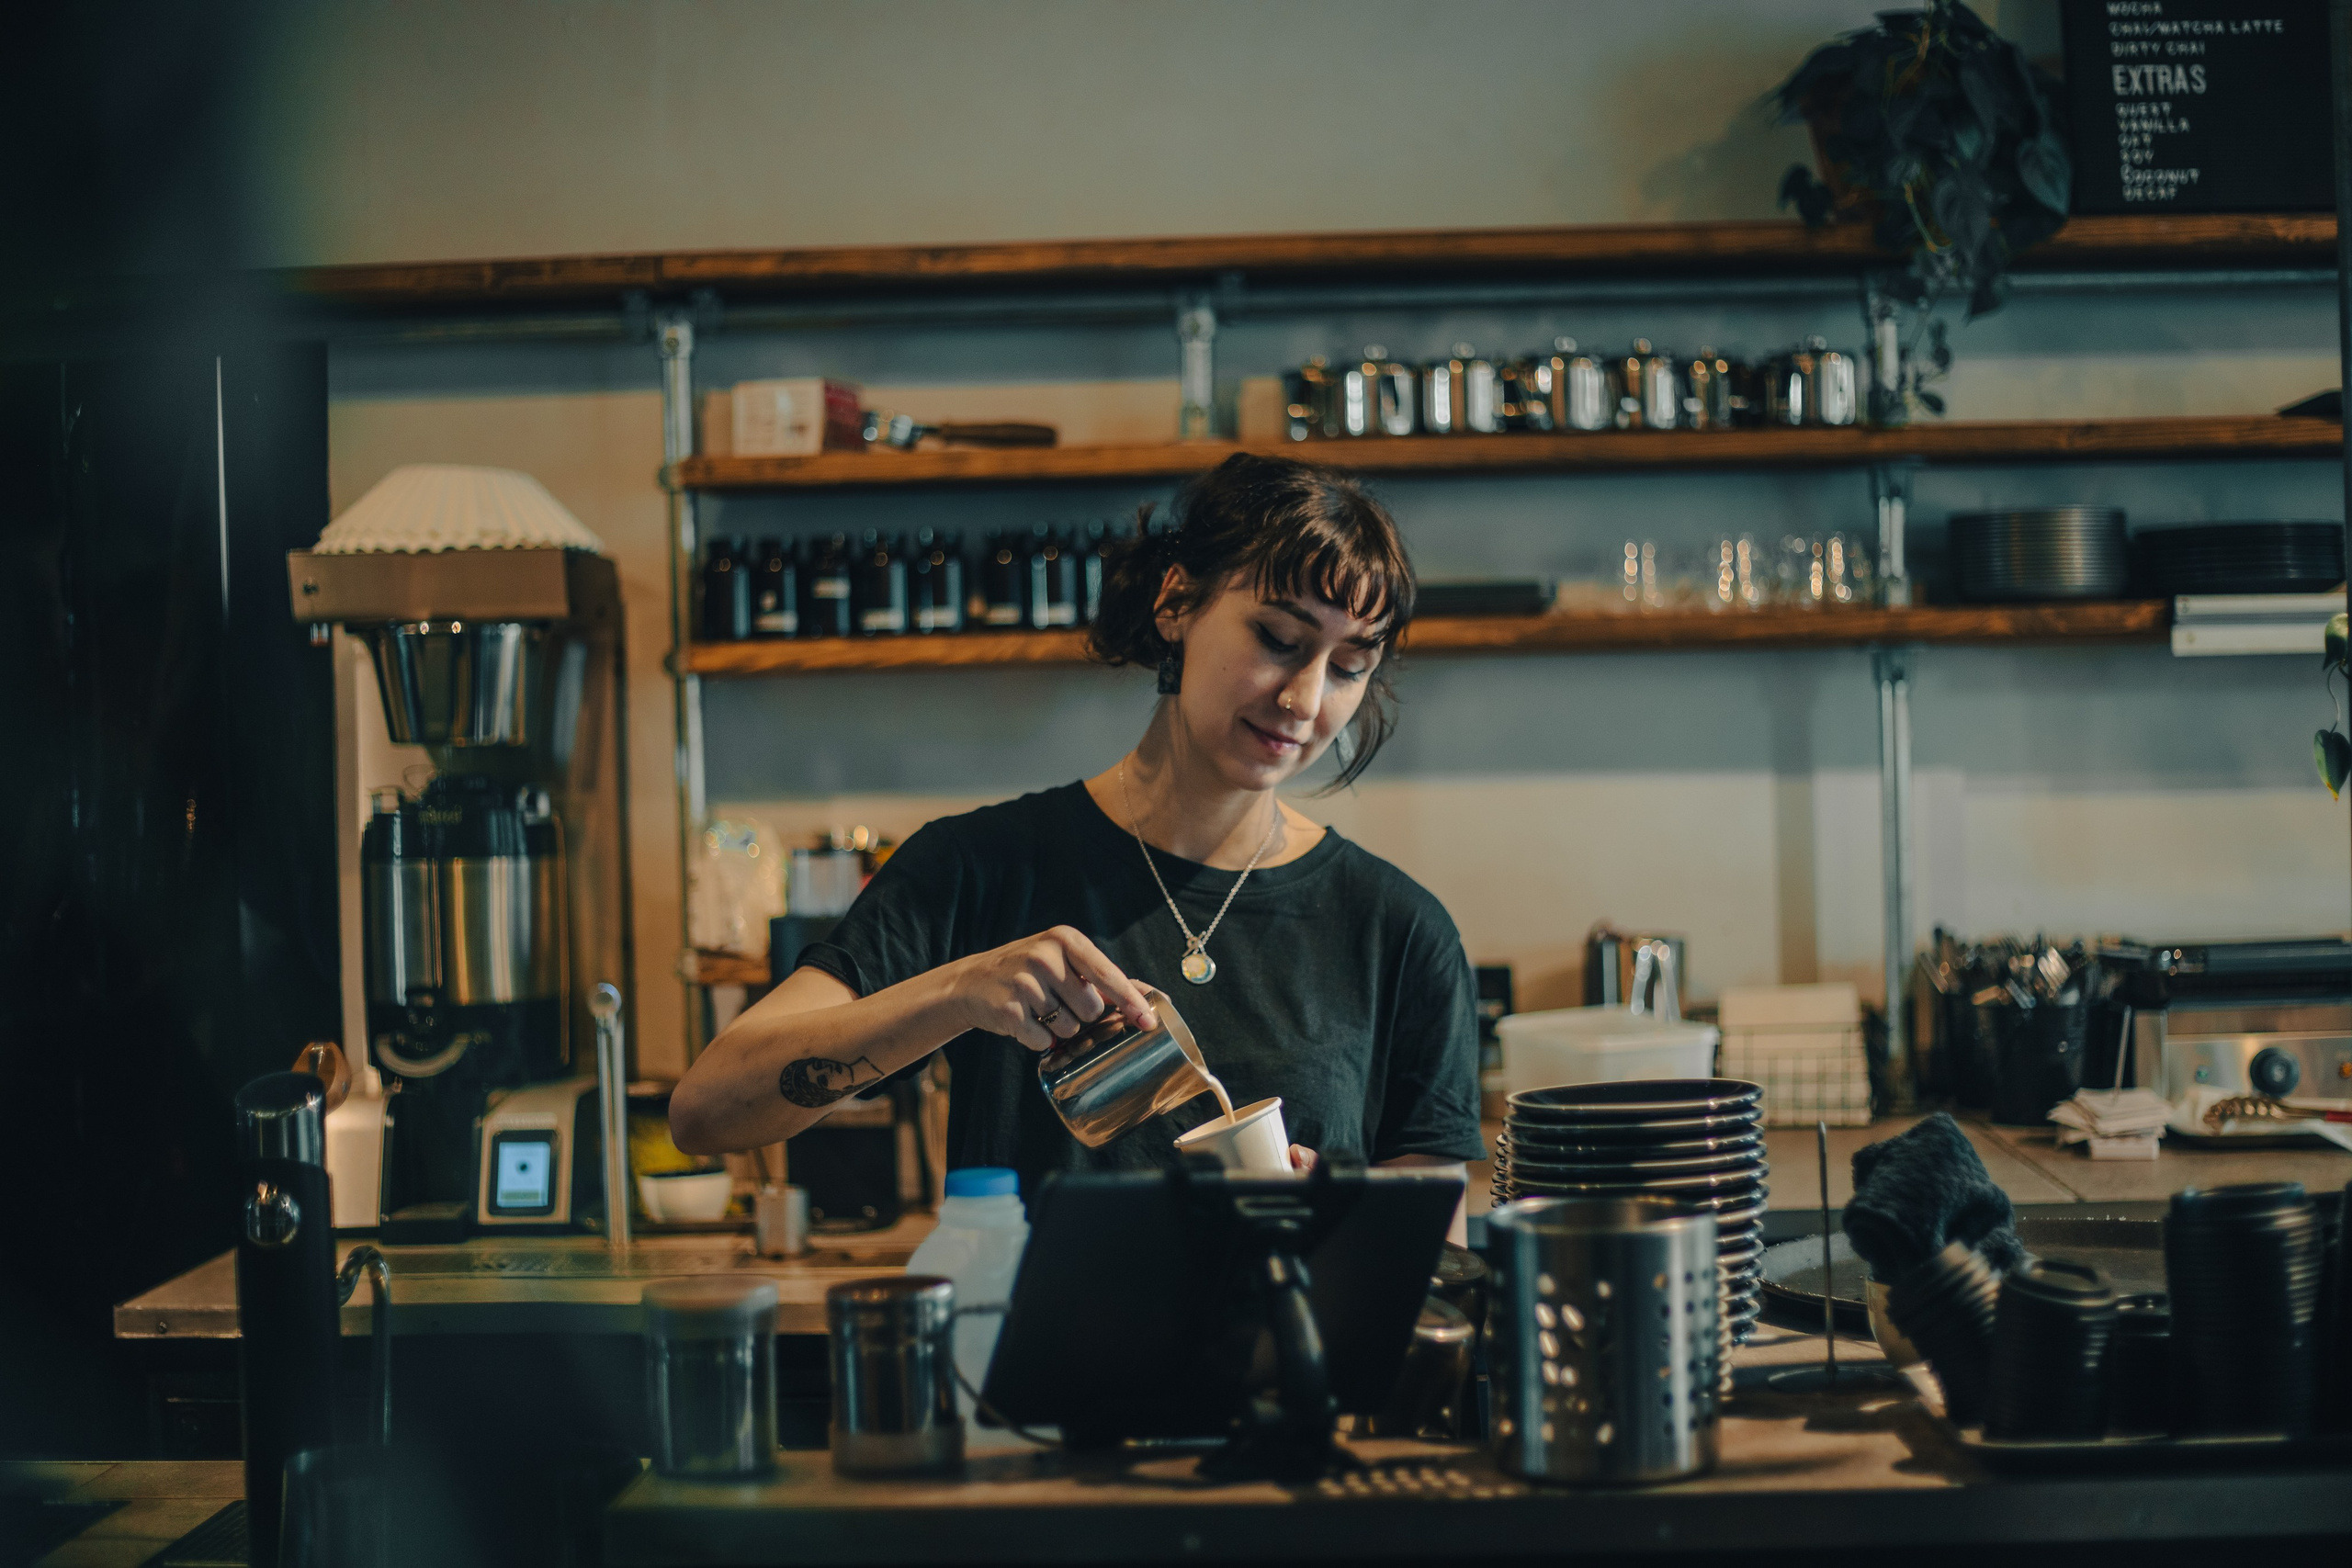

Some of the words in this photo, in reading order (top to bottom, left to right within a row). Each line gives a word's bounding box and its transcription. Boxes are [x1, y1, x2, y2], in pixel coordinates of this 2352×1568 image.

[2107, 2, 2162, 16] MOCHA
[2109, 20, 2225, 36] CHAI/MATCHA
[2230, 19, 2284, 34] LATTE
[2110, 41, 2160, 57] DIRTY
[2165, 41, 2205, 56] CHAI
[2112, 64, 2206, 96] EXTRAS
[2117, 118, 2190, 133] VANILLA
[2118, 133, 2152, 149] OAT
[2120, 149, 2154, 164] SOY
[2122, 184, 2177, 201] DECAF
